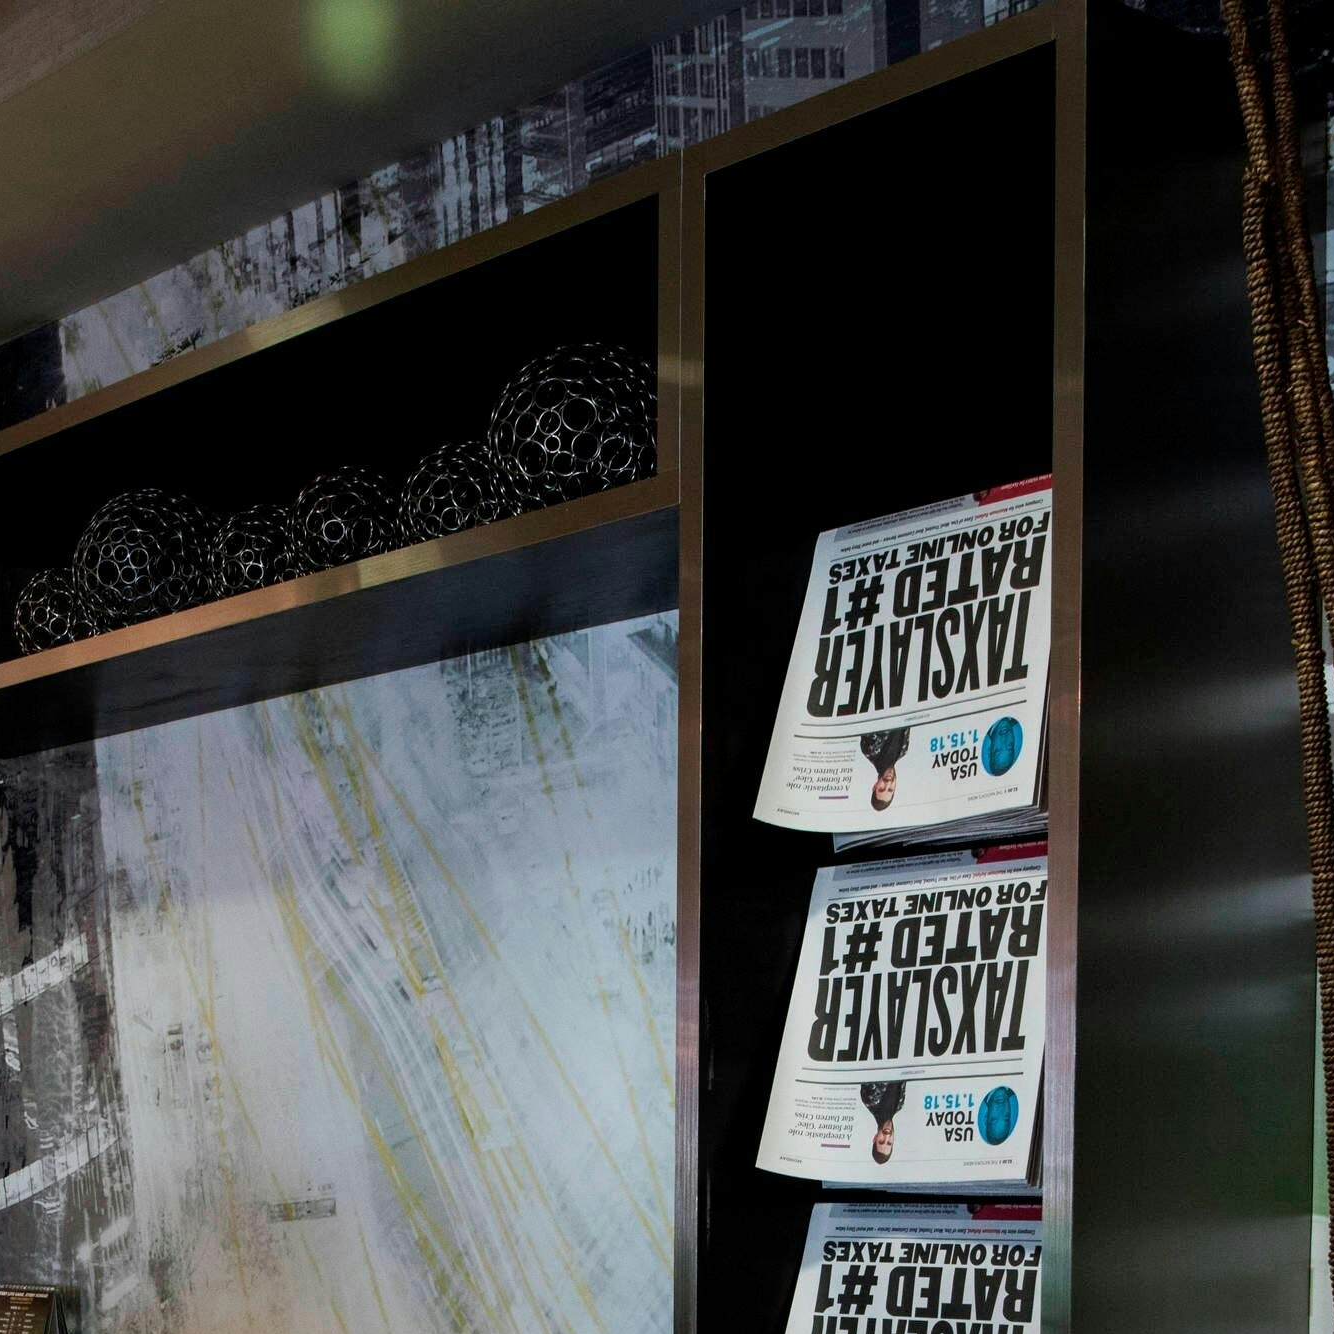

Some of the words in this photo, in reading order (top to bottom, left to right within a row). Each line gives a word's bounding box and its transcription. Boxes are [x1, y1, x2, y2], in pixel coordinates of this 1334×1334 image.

[998, 511, 1050, 542] FOR
[905, 526, 994, 565] ONLINE
[829, 548, 900, 584] TAXES
[893, 535, 1045, 616] RATED
[821, 574, 884, 634] #1
[808, 592, 1029, 716] TAXSLAYER
[929, 729, 978, 752] 1.15.18
[931, 745, 978, 768] TODAY
[792, 765, 812, 774] Criss
[813, 767, 838, 775] Darren
[815, 776, 840, 784] former
[949, 761, 977, 780] USA
[785, 781, 801, 790] role
[802, 783, 843, 792] creeptastic
[903, 886, 991, 915] ONLINE
[996, 879, 1047, 905] FOR
[826, 896, 898, 924] TAXES
[891, 904, 1042, 967] RATED
[819, 921, 882, 975] #1
[809, 961, 1027, 1061] TAXSLAYER
[923, 1093, 974, 1110] 1.15.18
[794, 1111, 814, 1120] Criss
[815, 1113, 840, 1123] Darren
[925, 1110, 974, 1126] TODAY
[787, 1127, 803, 1136] role
[804, 1130, 845, 1139] creeptastic
[817, 1123, 842, 1133] former
[944, 1126, 973, 1142] USA
[822, 1240, 894, 1263] TAXES
[898, 1242, 986, 1265] ONLINE
[990, 1243, 1042, 1267] FOR
[815, 1263, 877, 1314] #1
[886, 1266, 1036, 1322] RATED
